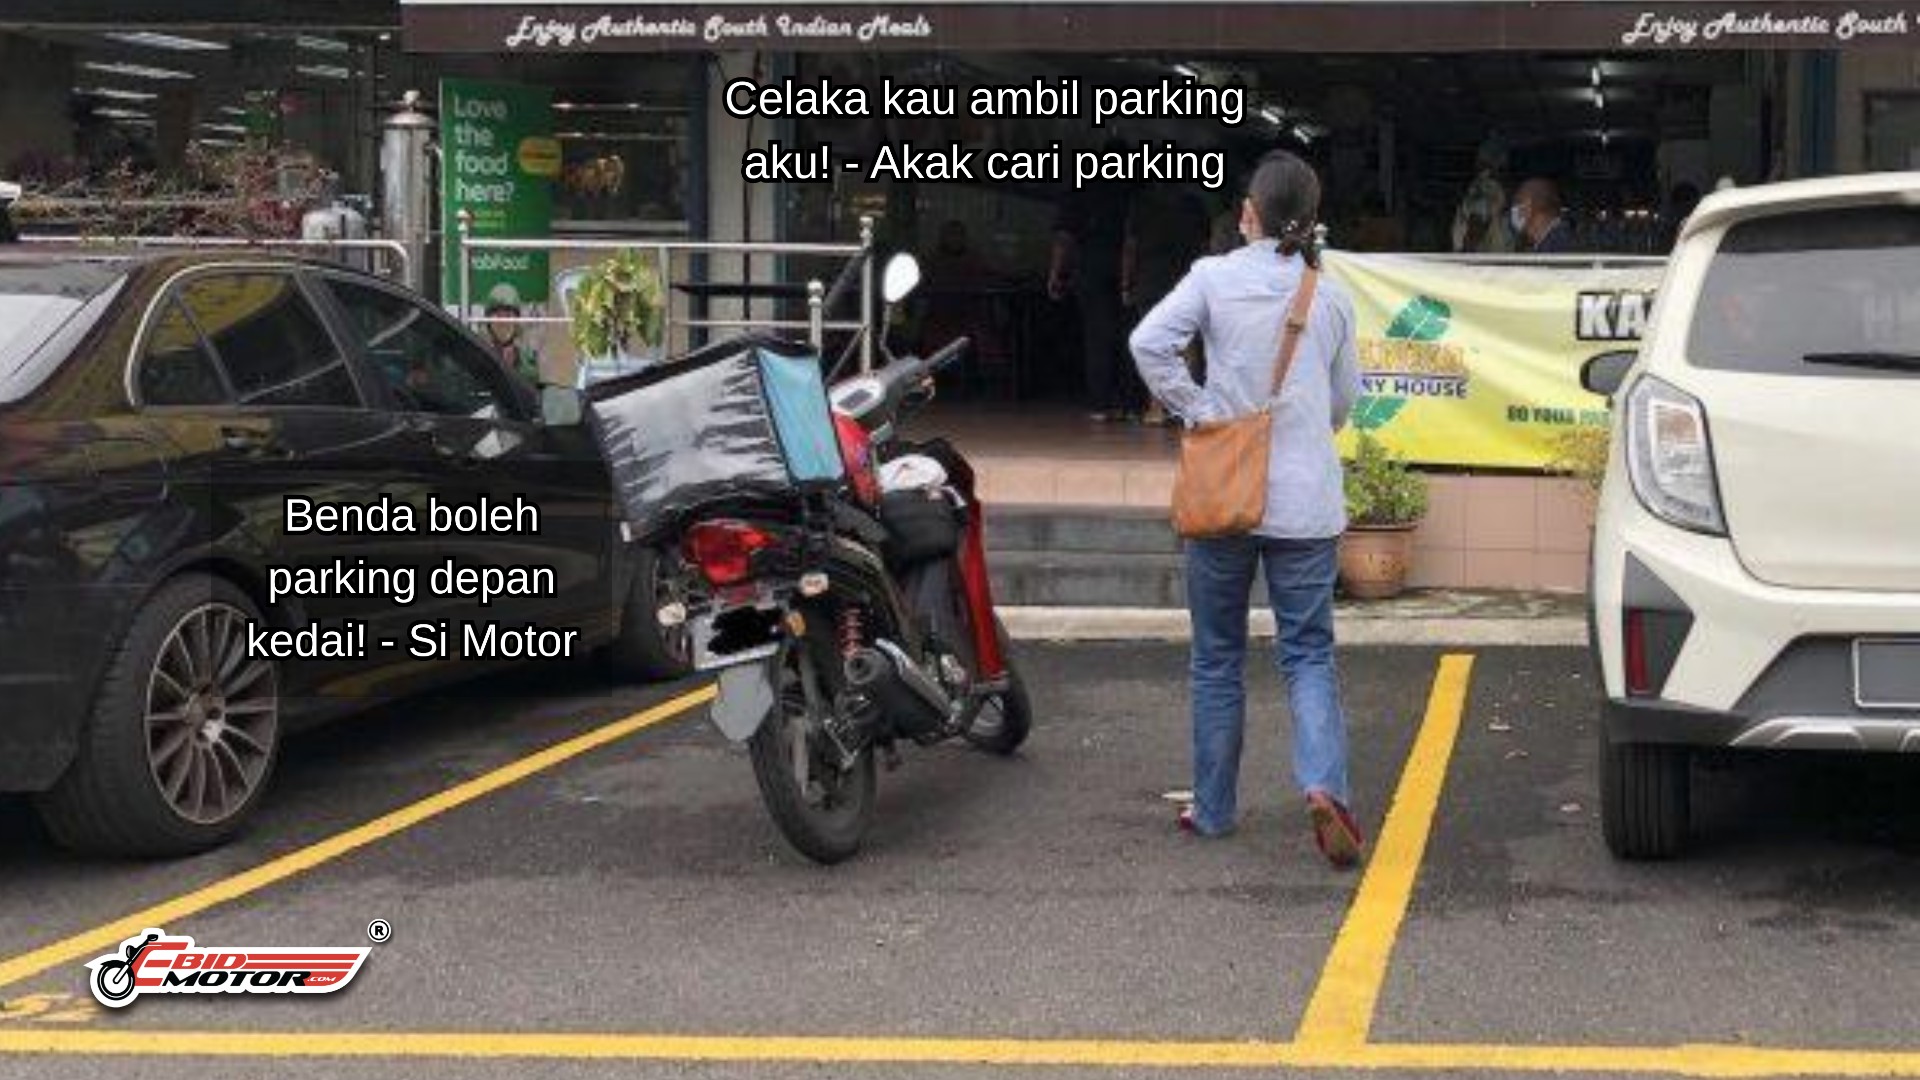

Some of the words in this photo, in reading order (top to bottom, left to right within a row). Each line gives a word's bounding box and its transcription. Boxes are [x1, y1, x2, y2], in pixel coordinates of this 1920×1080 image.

[506, 15, 576, 46] Enjoy
[580, 14, 696, 43] Authentic
[703, 14, 768, 42] South
[775, 13, 851, 37] Indian
[857, 14, 932, 41] Meals
[1621, 12, 1698, 44] Enjoy
[1702, 11, 1830, 40] Authentic
[1835, 10, 1908, 40] South
[454, 97, 507, 117] Love
[455, 125, 493, 147] the
[456, 150, 508, 176] food
[457, 179, 515, 202] here?
[1393, 378, 1468, 400] HOUSE
